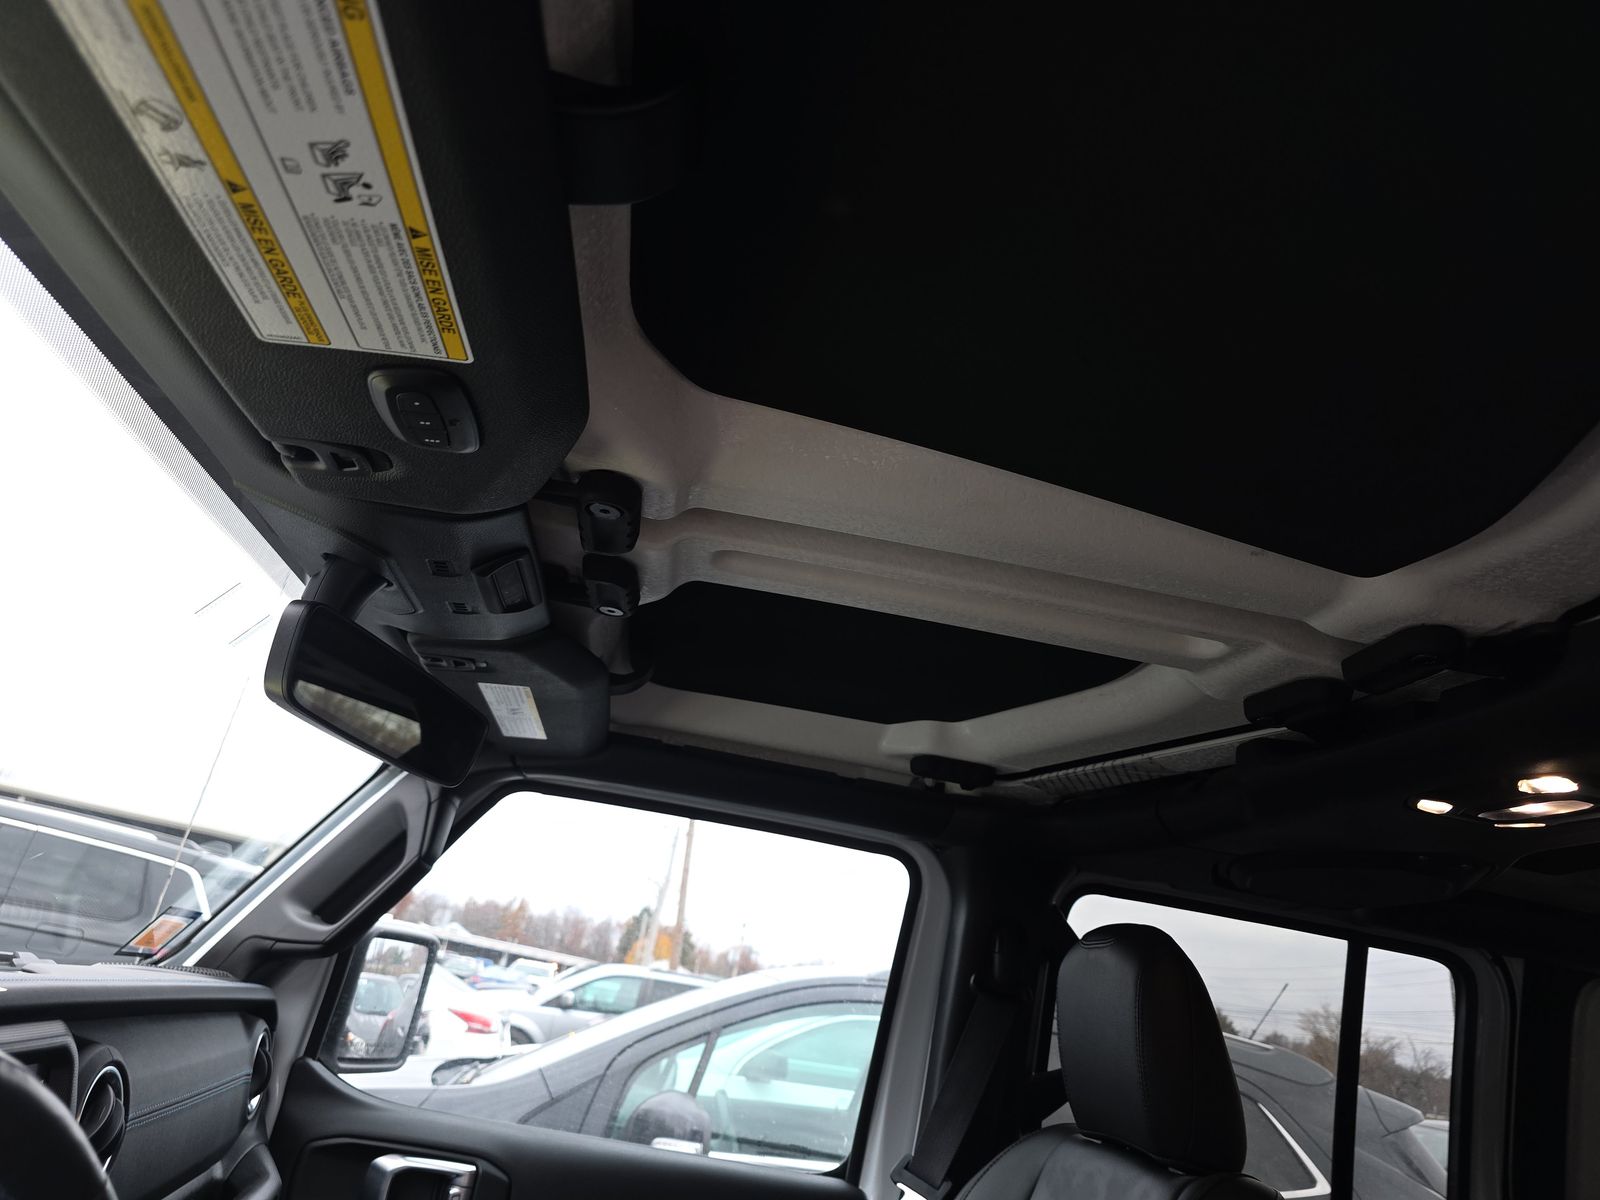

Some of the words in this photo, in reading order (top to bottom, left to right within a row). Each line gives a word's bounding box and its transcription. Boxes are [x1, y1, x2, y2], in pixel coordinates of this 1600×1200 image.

[238, 202, 268, 235] MISE
[257, 237, 278, 256] EN
[269, 256, 302, 300] GARDE
[415, 246, 437, 276] MISE
[424, 278, 442, 294] EN
[432, 298, 456, 334] GARDE
